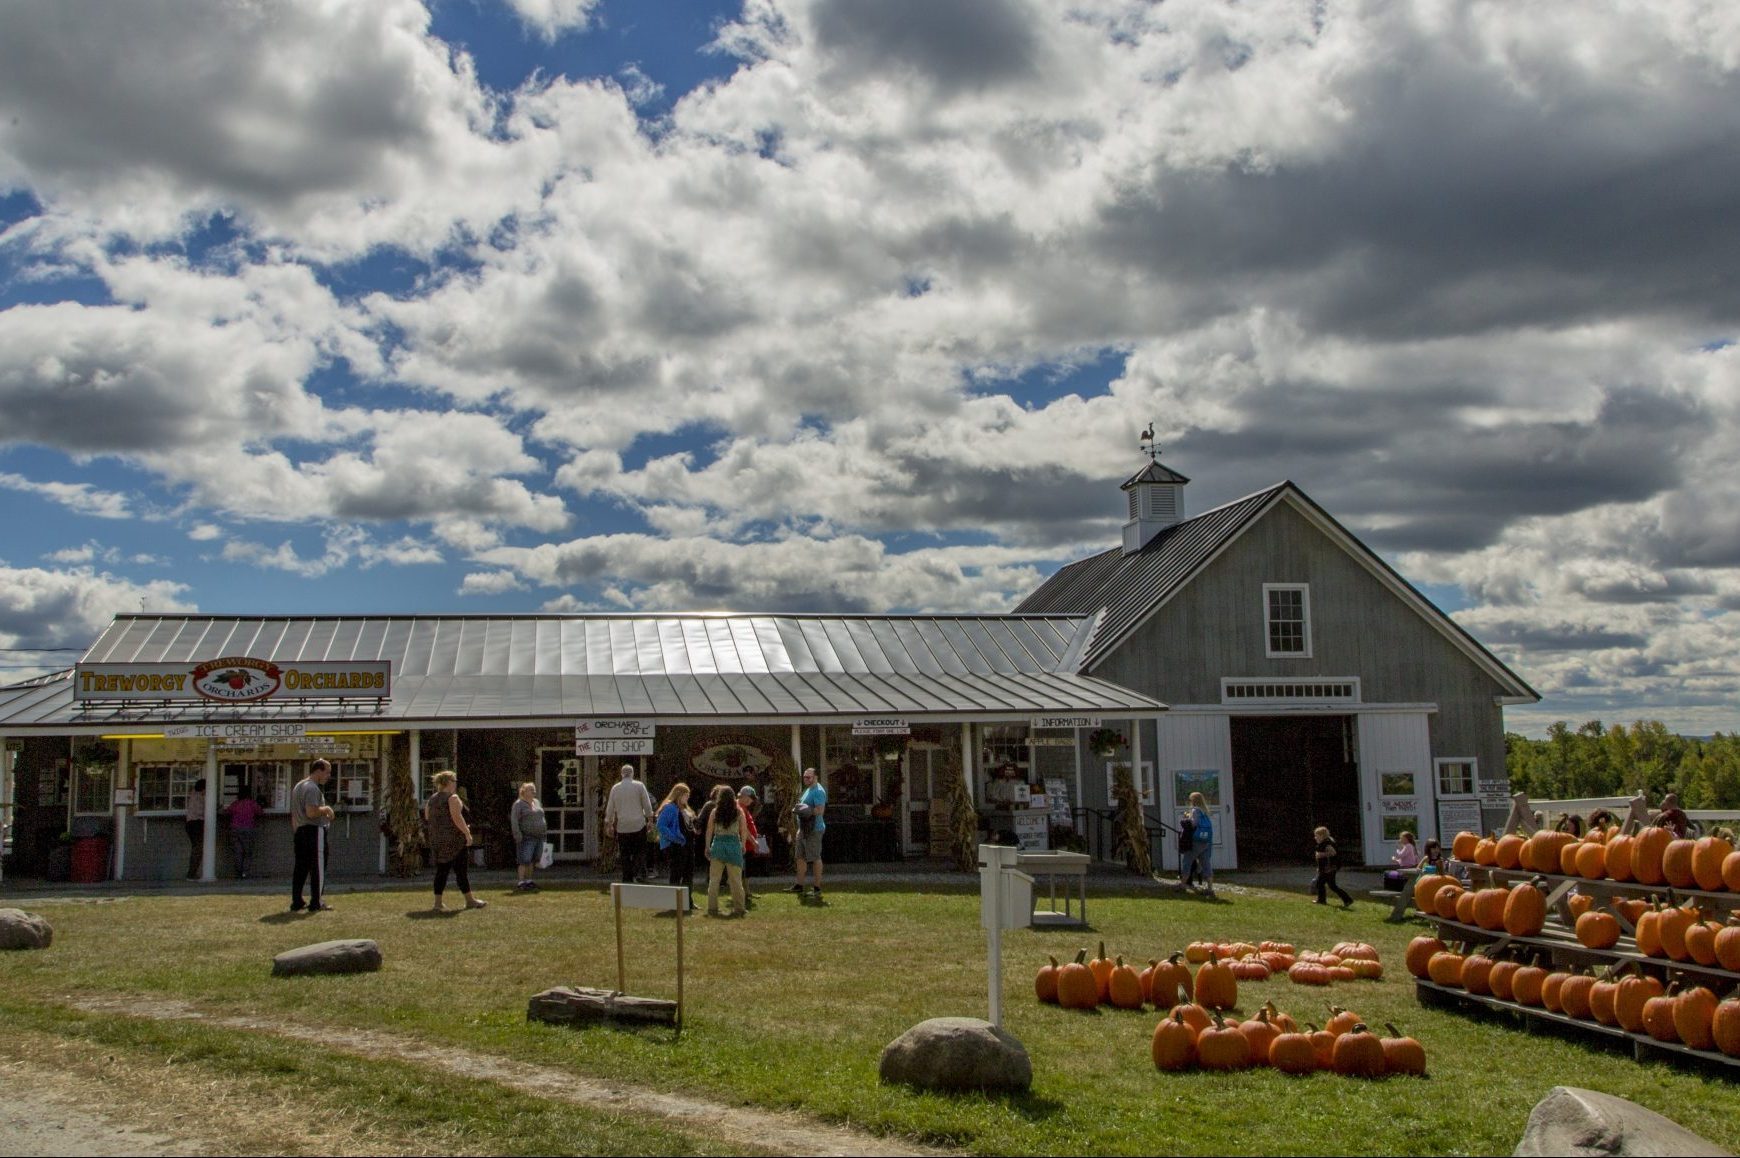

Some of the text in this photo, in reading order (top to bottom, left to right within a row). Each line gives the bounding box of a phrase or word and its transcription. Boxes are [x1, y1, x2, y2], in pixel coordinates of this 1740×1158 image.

[202, 657, 271, 672] TREWORGY
[80, 671, 187, 692] TREWORGY
[284, 668, 385, 690] ORCHARDS
[202, 683, 271, 698] ORCHARDS
[576, 721, 640, 734] THE ORCHARD
[1041, 717, 1091, 727] INFORMATION
[195, 725, 220, 737] ICE
[225, 724, 266, 737] CREAM
[270, 724, 304, 736] SHOP
[578, 740, 646, 753] THE GIFT SHOP
